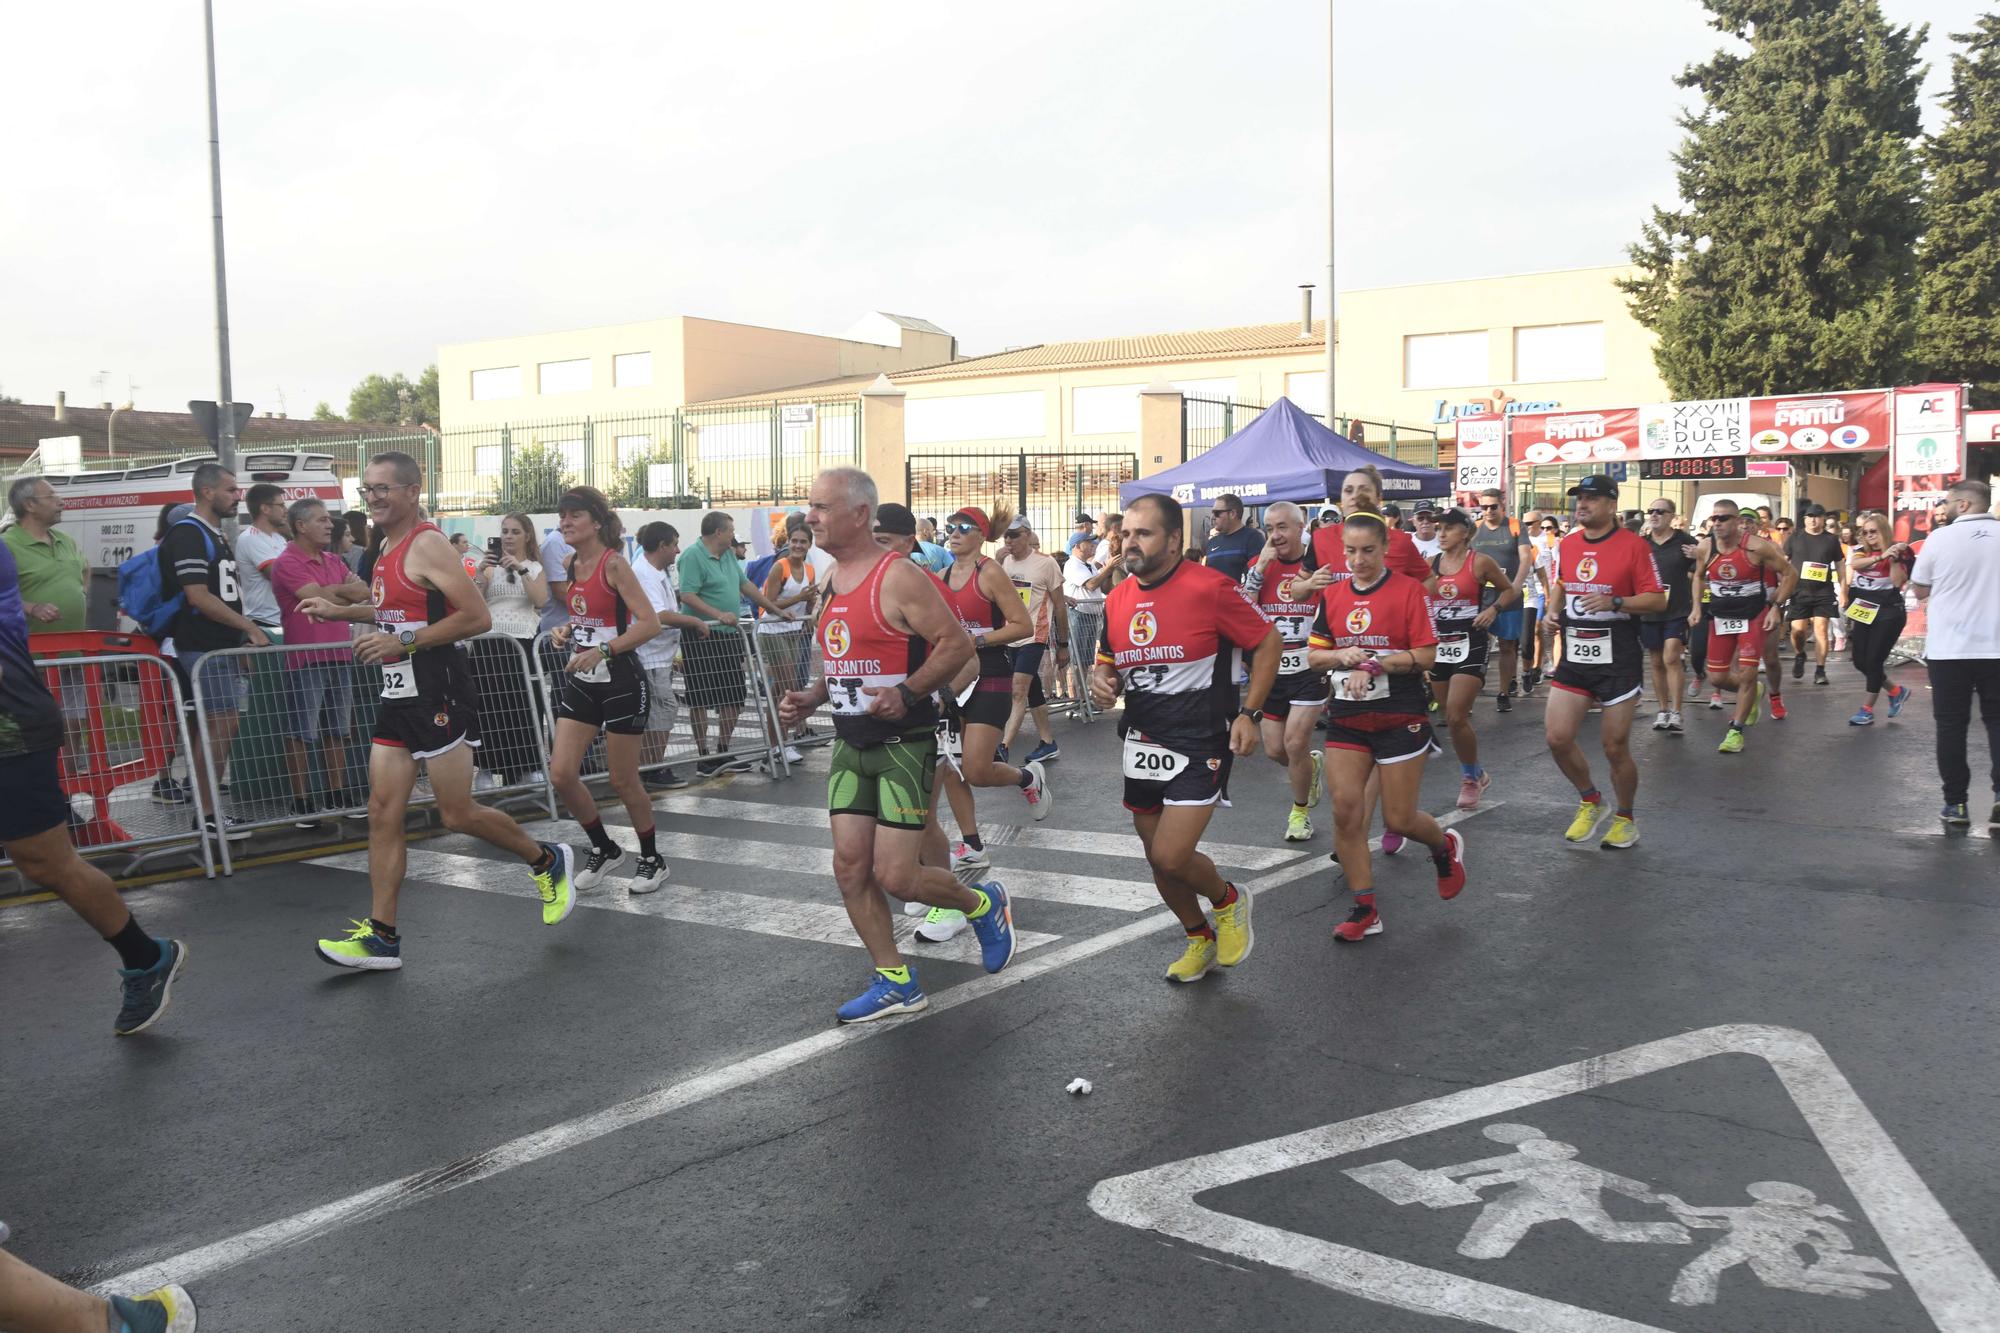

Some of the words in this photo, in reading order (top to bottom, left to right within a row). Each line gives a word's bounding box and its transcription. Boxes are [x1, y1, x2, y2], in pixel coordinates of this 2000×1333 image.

[1674, 402, 1740, 417] XXVIII
[1675, 416, 1740, 430] NON
[1675, 428, 1741, 443] DUER
[1674, 442, 1741, 455] MAS
[1662, 458, 1734, 476] 0:00:55
[1722, 620, 1743, 629] 183
[1144, 645, 1185, 662] SANTOS
[1438, 647, 1462, 658] 346
[1574, 644, 1601, 657] 298
[837, 659, 881, 675] SANTOS
[1128, 664, 1169, 692] CT
[1134, 752, 1176, 771] 200
